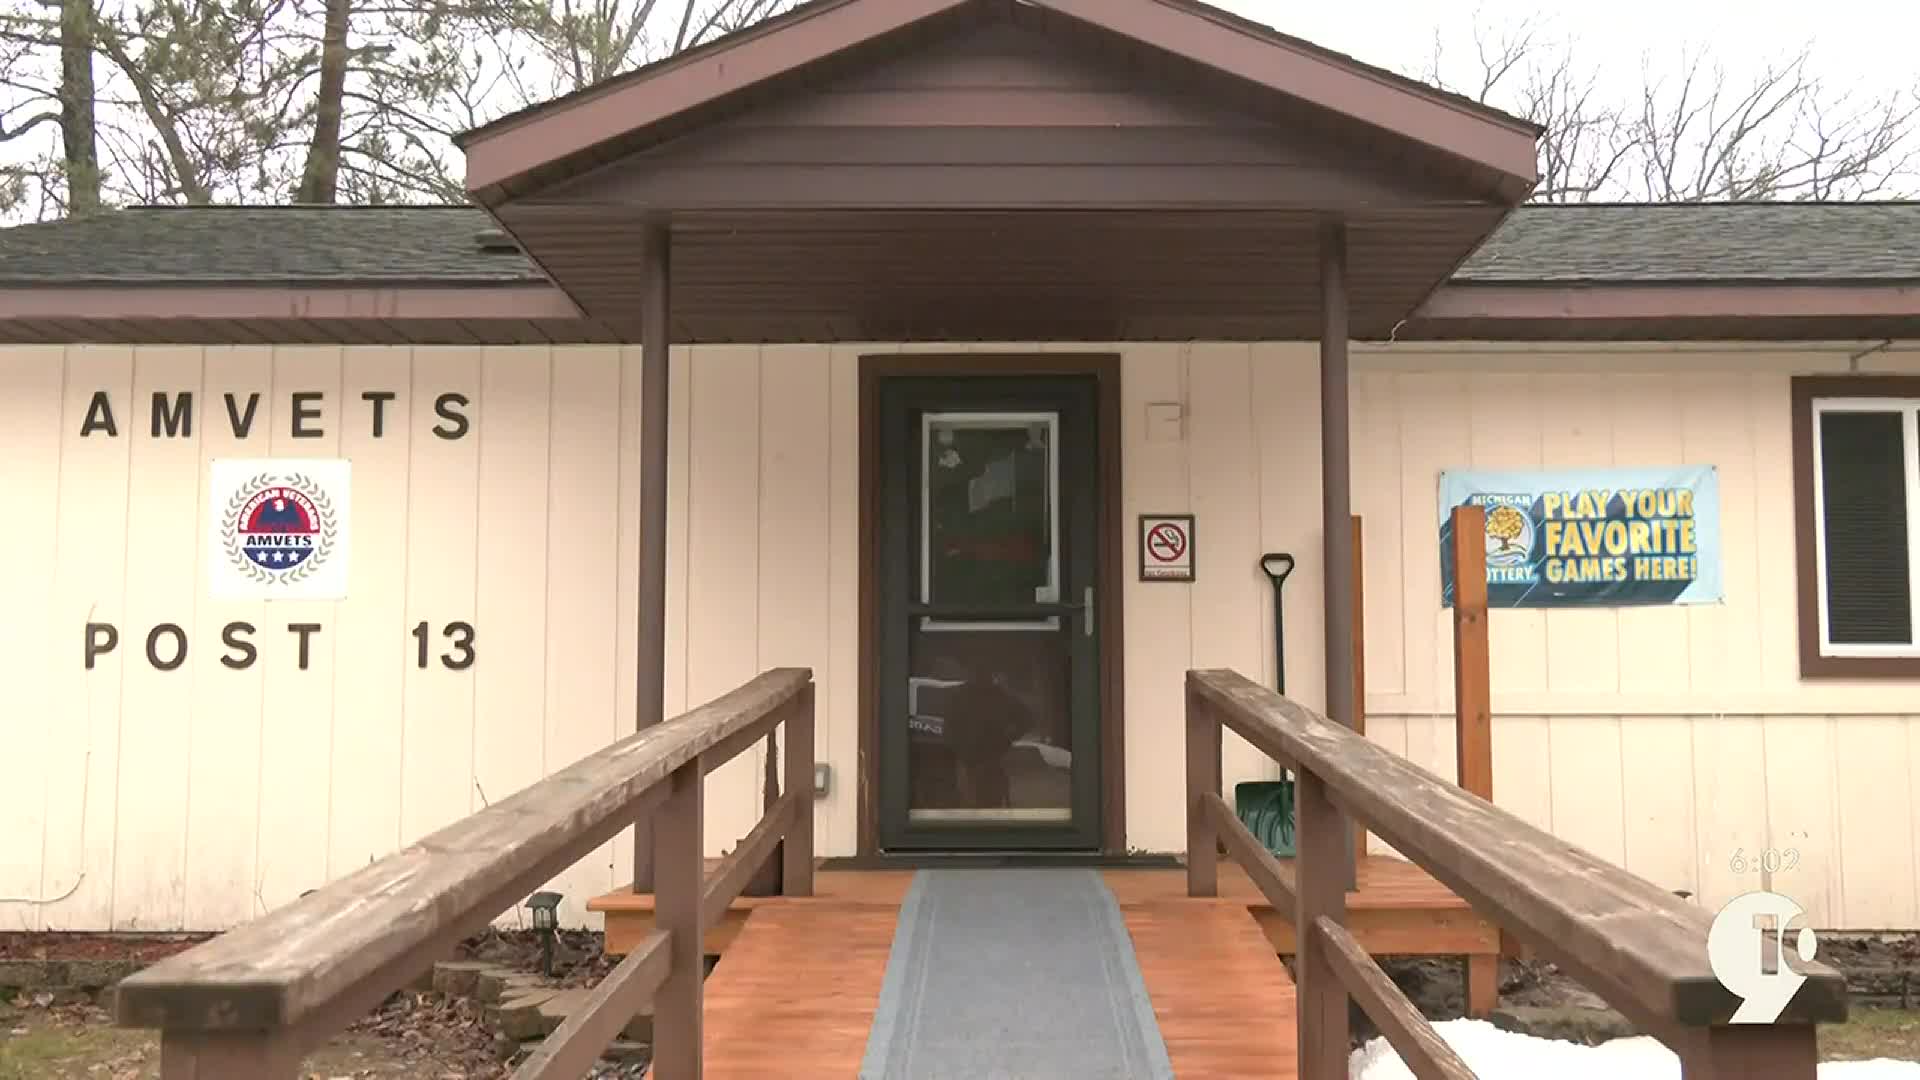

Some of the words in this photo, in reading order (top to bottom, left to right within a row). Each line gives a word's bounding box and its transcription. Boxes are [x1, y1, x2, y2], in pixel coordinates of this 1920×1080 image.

[80, 391, 470, 440] AMVETS
[1471, 494, 1532, 506] MICHIGAN
[1543, 490, 1610, 519] PLAY
[1620, 488, 1694, 518] YOUR
[246, 535, 312, 546] AMVETS
[1545, 518, 1697, 556] FAVORITE
[1486, 566, 1534, 582] OTTERY
[1546, 556, 1627, 583] GAMES
[1634, 556, 1697, 581] HERE!
[84, 622, 322, 671] POST
[411, 621, 476, 671] 13
